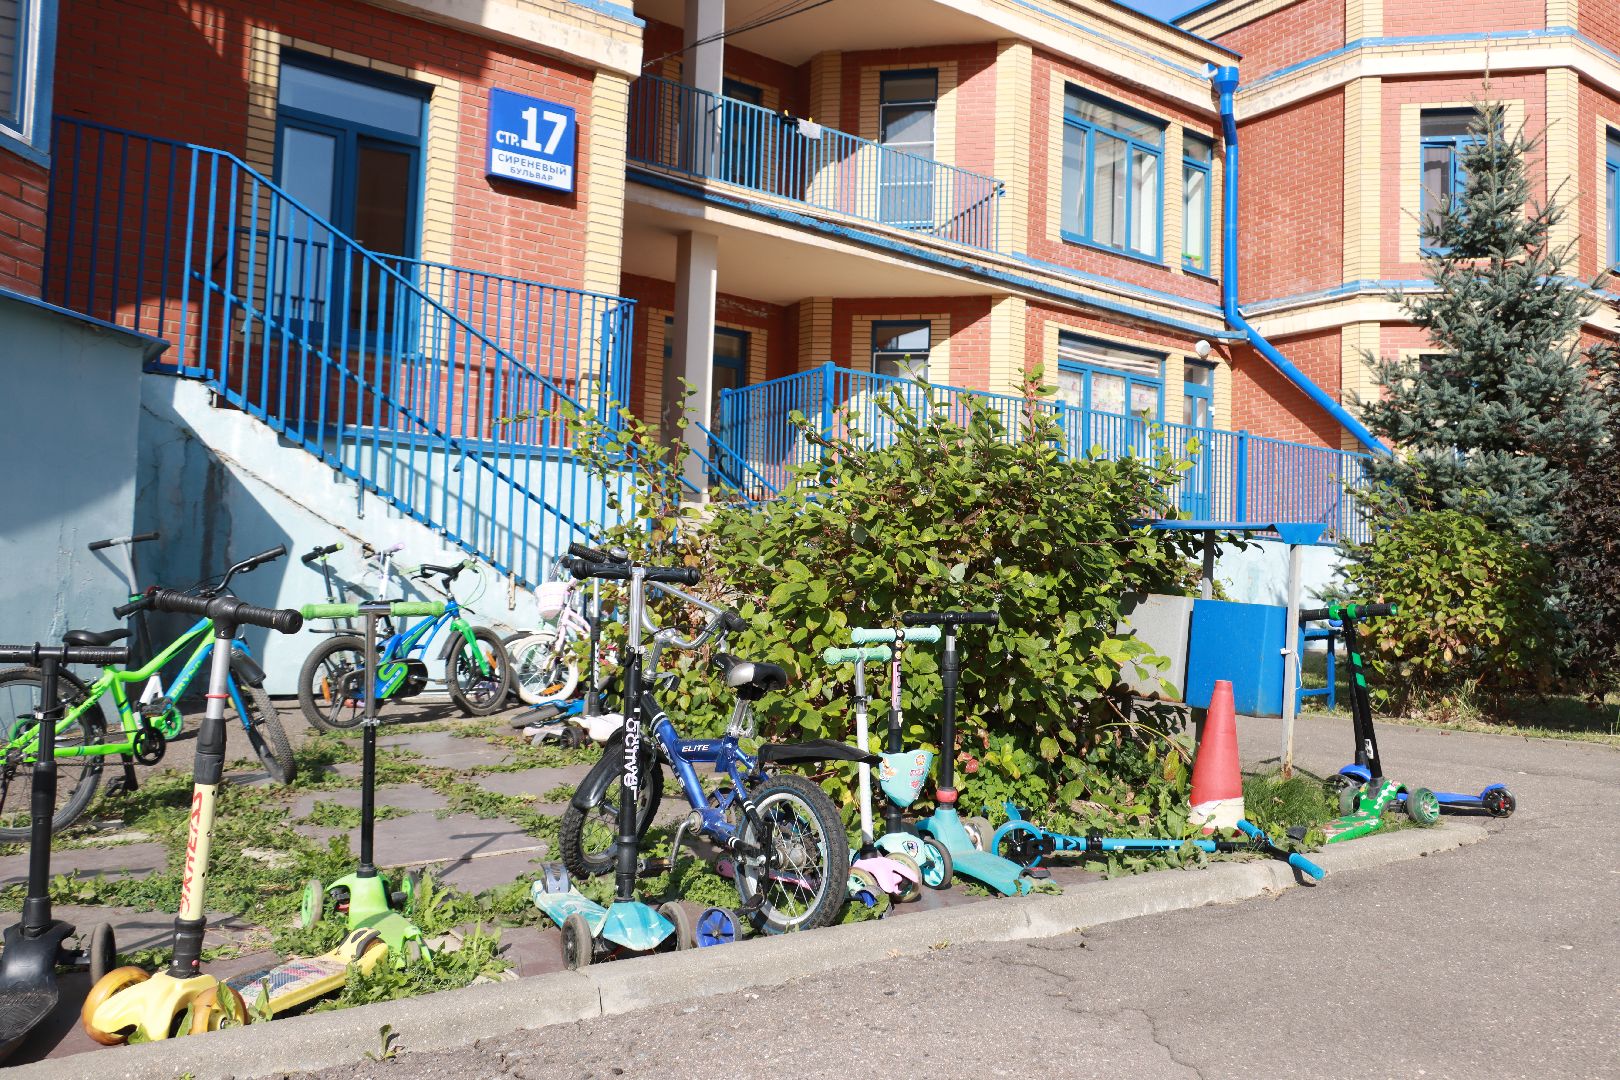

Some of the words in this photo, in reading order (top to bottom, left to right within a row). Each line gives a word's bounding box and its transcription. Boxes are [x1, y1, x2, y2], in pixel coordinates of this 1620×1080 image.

[495, 130, 520, 147] СТР.
[521, 107, 568, 155] 17
[498, 153, 567, 176] СИРЕНЕВЫЙ
[510, 166, 553, 182] БУЛЬВАР
[682, 744, 710, 752] ELITE
